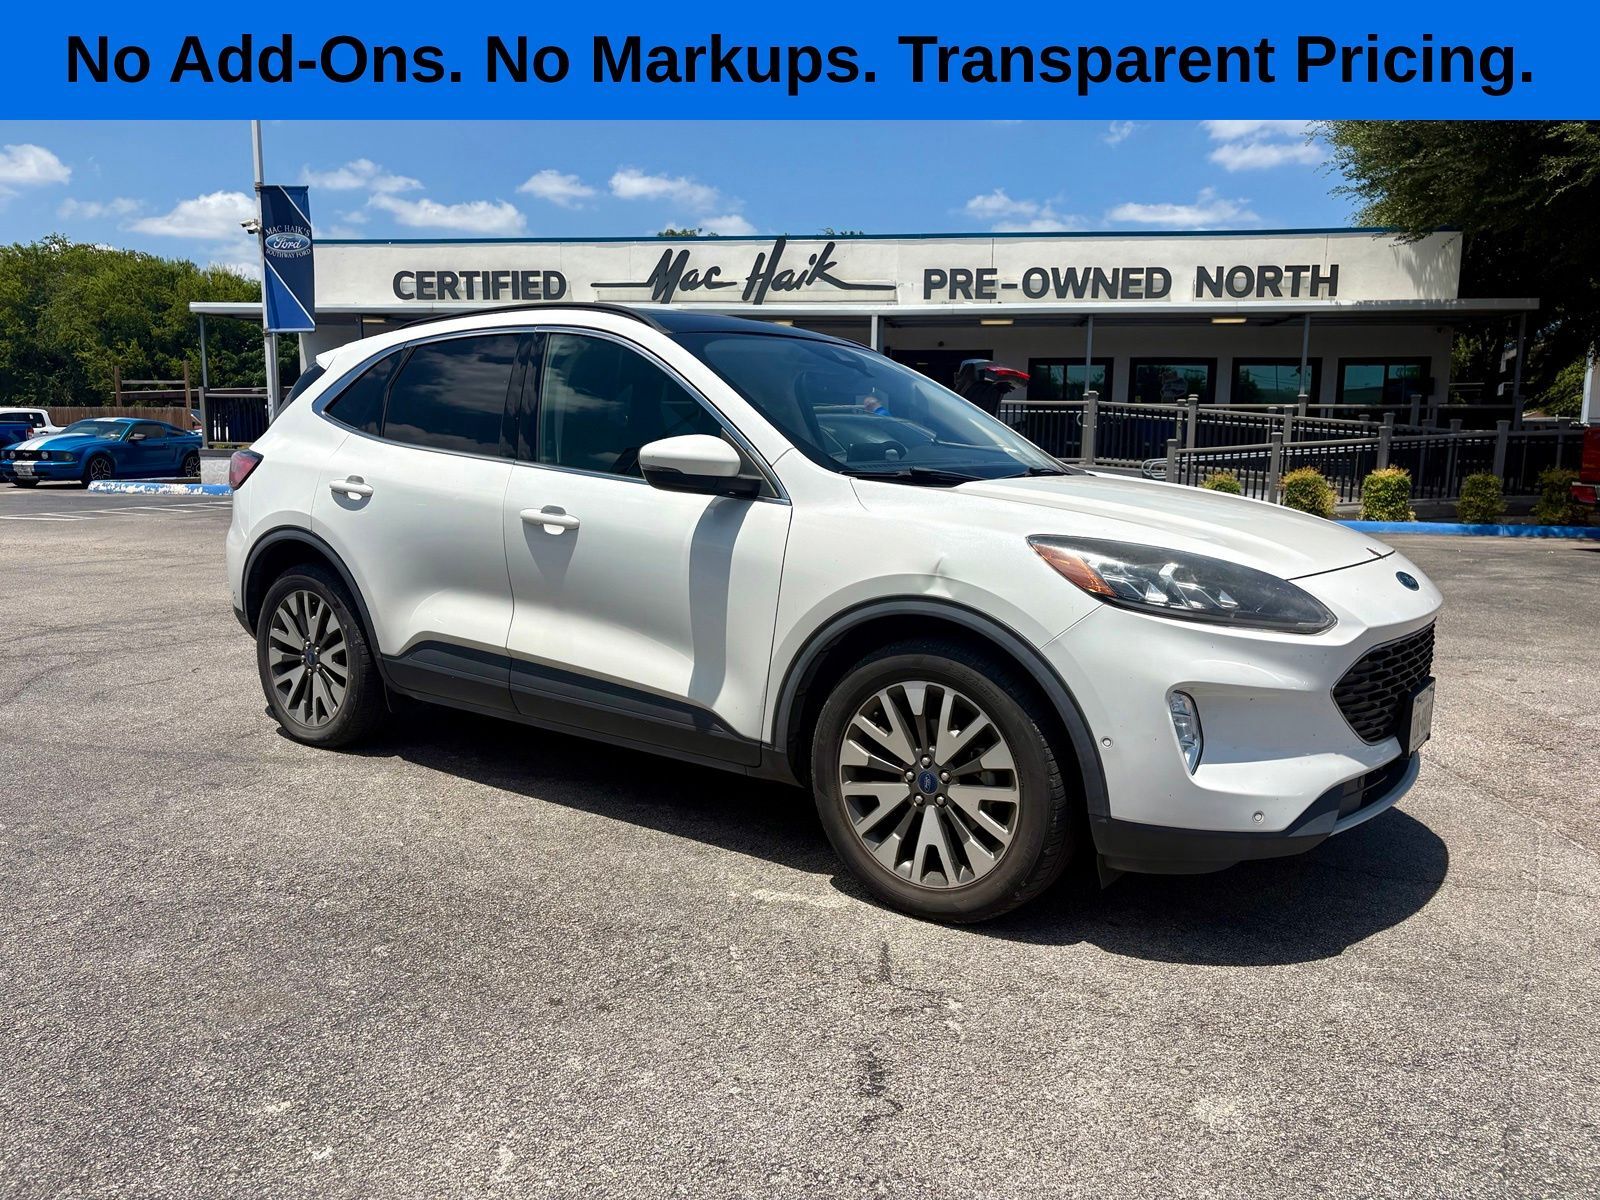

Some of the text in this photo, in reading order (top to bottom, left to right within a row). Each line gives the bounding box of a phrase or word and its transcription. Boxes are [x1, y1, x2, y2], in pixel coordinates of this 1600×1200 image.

[266, 225, 310, 236] MAC HAIK'S
[273, 236, 301, 248] Ford
[266, 248, 311, 258] SOUTHWAY FORD
[591, 238, 896, 305] Mac Haik
[923, 264, 1340, 300] PRE-OWNED NORTH
[393, 270, 567, 301] CERTIFIED
